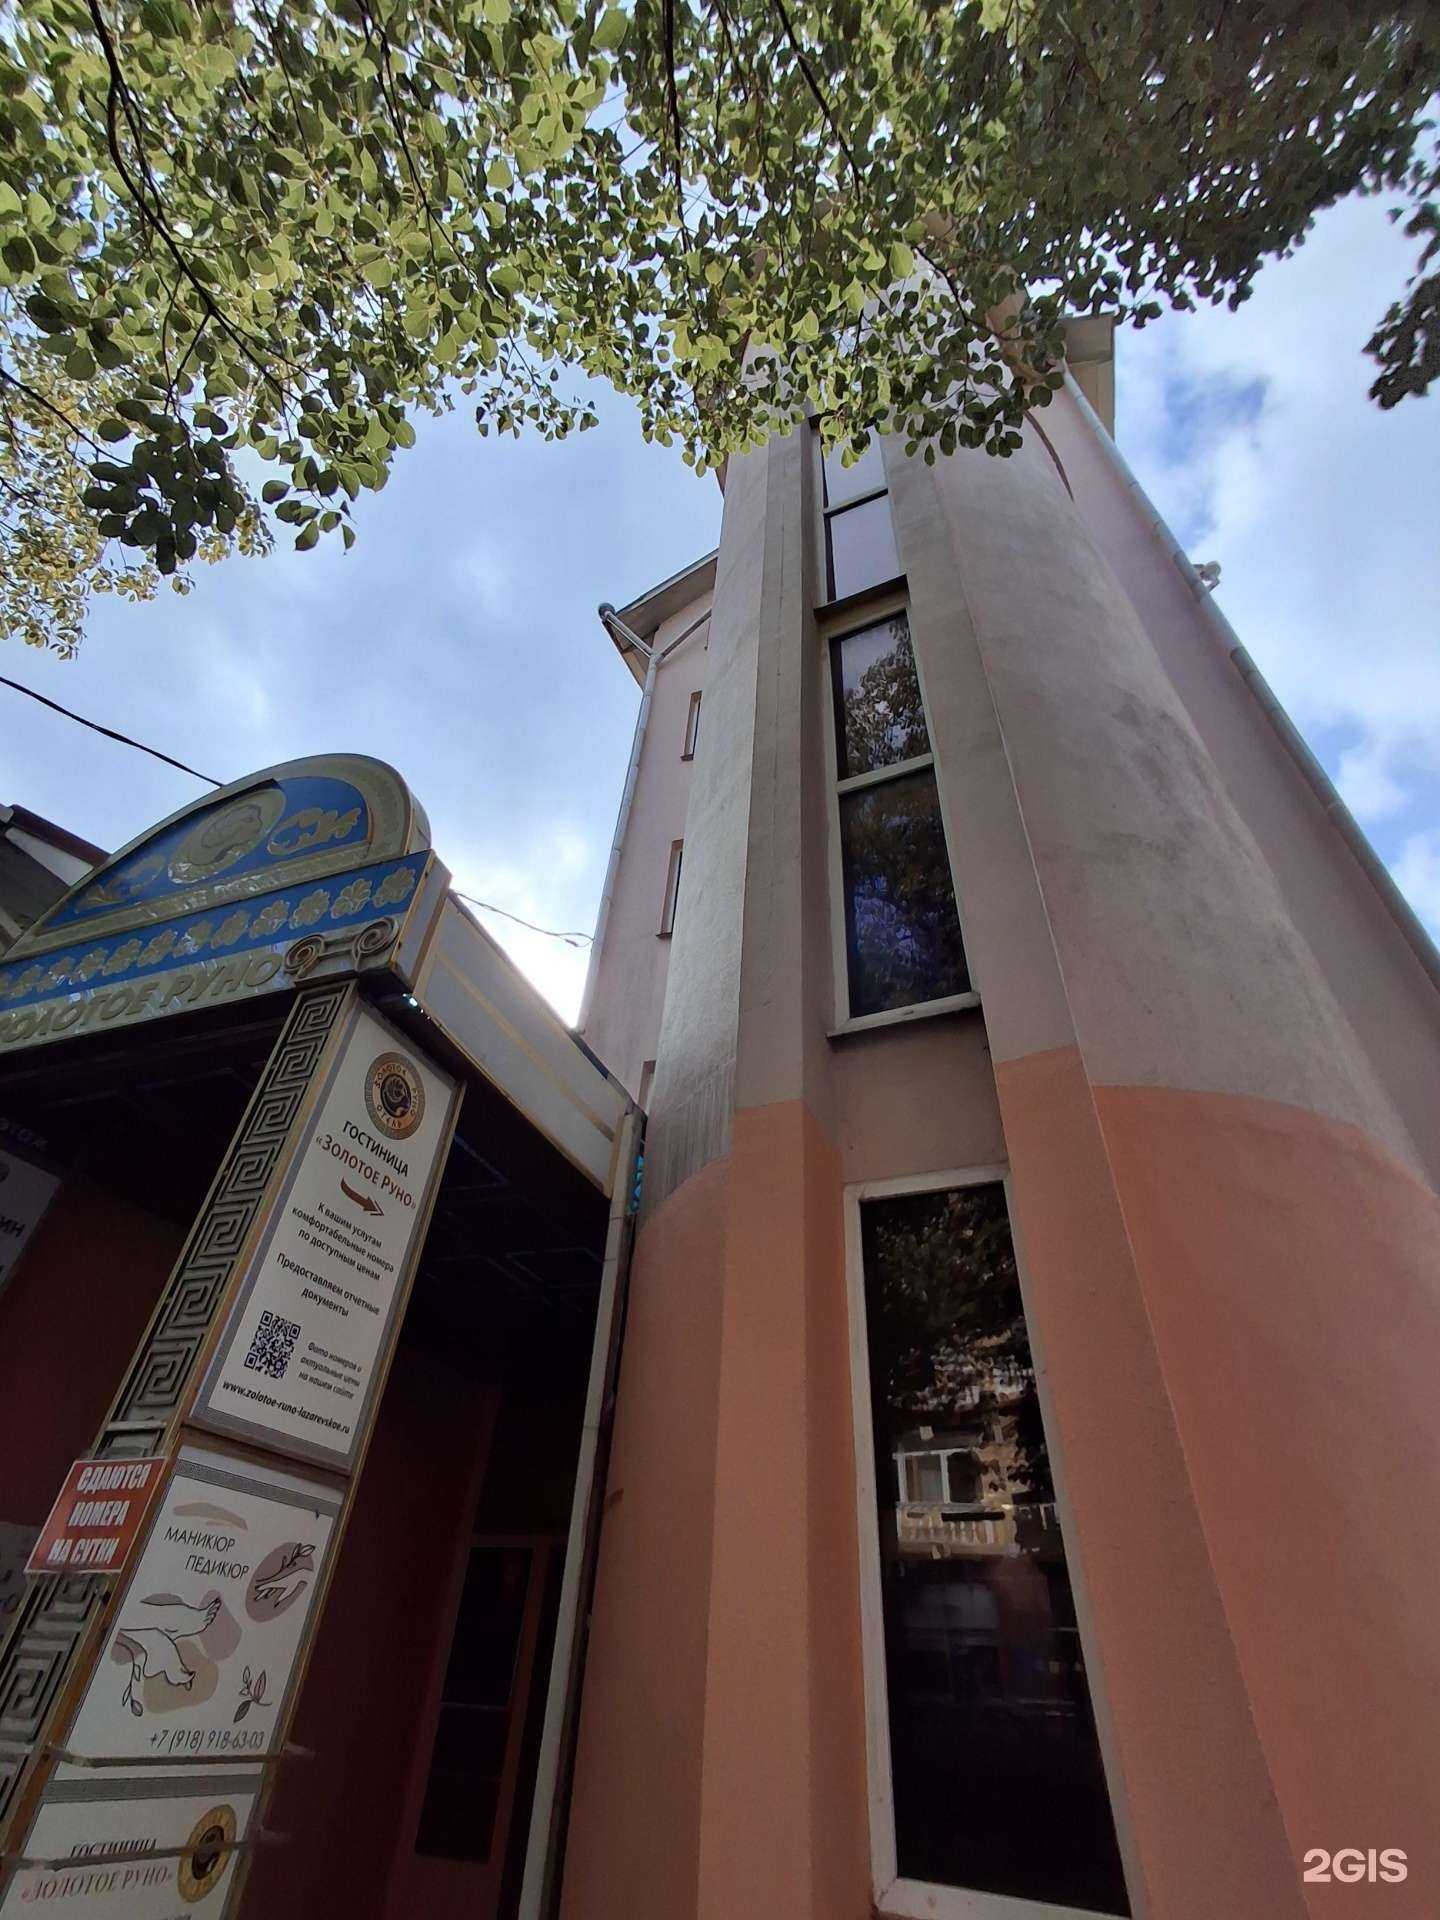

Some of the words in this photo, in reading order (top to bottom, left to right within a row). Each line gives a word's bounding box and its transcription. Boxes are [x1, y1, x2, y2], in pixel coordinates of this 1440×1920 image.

[0, 981, 159, 1043] ОЛОТОЕ
[160, 952, 283, 1008] РУНО
[342, 1121, 409, 1177] ГОСТИНИЦА
[316, 1134, 381, 1184] «ЗОЛОТОЕ
[381, 1175, 416, 1209] РУНО»
[292, 1207, 367, 1256] комфортабельные
[366, 1252, 394, 1273] номера
[318, 1202, 325, 1212] К
[324, 1208, 352, 1230] вашим
[352, 1225, 382, 1248] услугам
[298, 1228, 310, 1241] по
[310, 1236, 356, 1267] доступным
[356, 1263, 380, 1281] ценам
[276, 1252, 343, 1295] Предоставляем
[343, 1291, 380, 1315] отчетные
[301, 1288, 349, 1317] документы
[77, 1463, 152, 1494] СДАЮТСЯ
[68, 1500, 130, 1527] НОМЕРА
[47, 1538, 73, 1562] НА
[70, 1537, 120, 1564] СУТКИ
[163, 1526, 236, 1552] МАНИКЮР
[184, 1554, 250, 1580] ПЕДИКЮР
[151, 1729, 169, 1749] +7
[168, 1729, 205, 1754] (918)
[207, 1729, 265, 1750] 918-63-03
